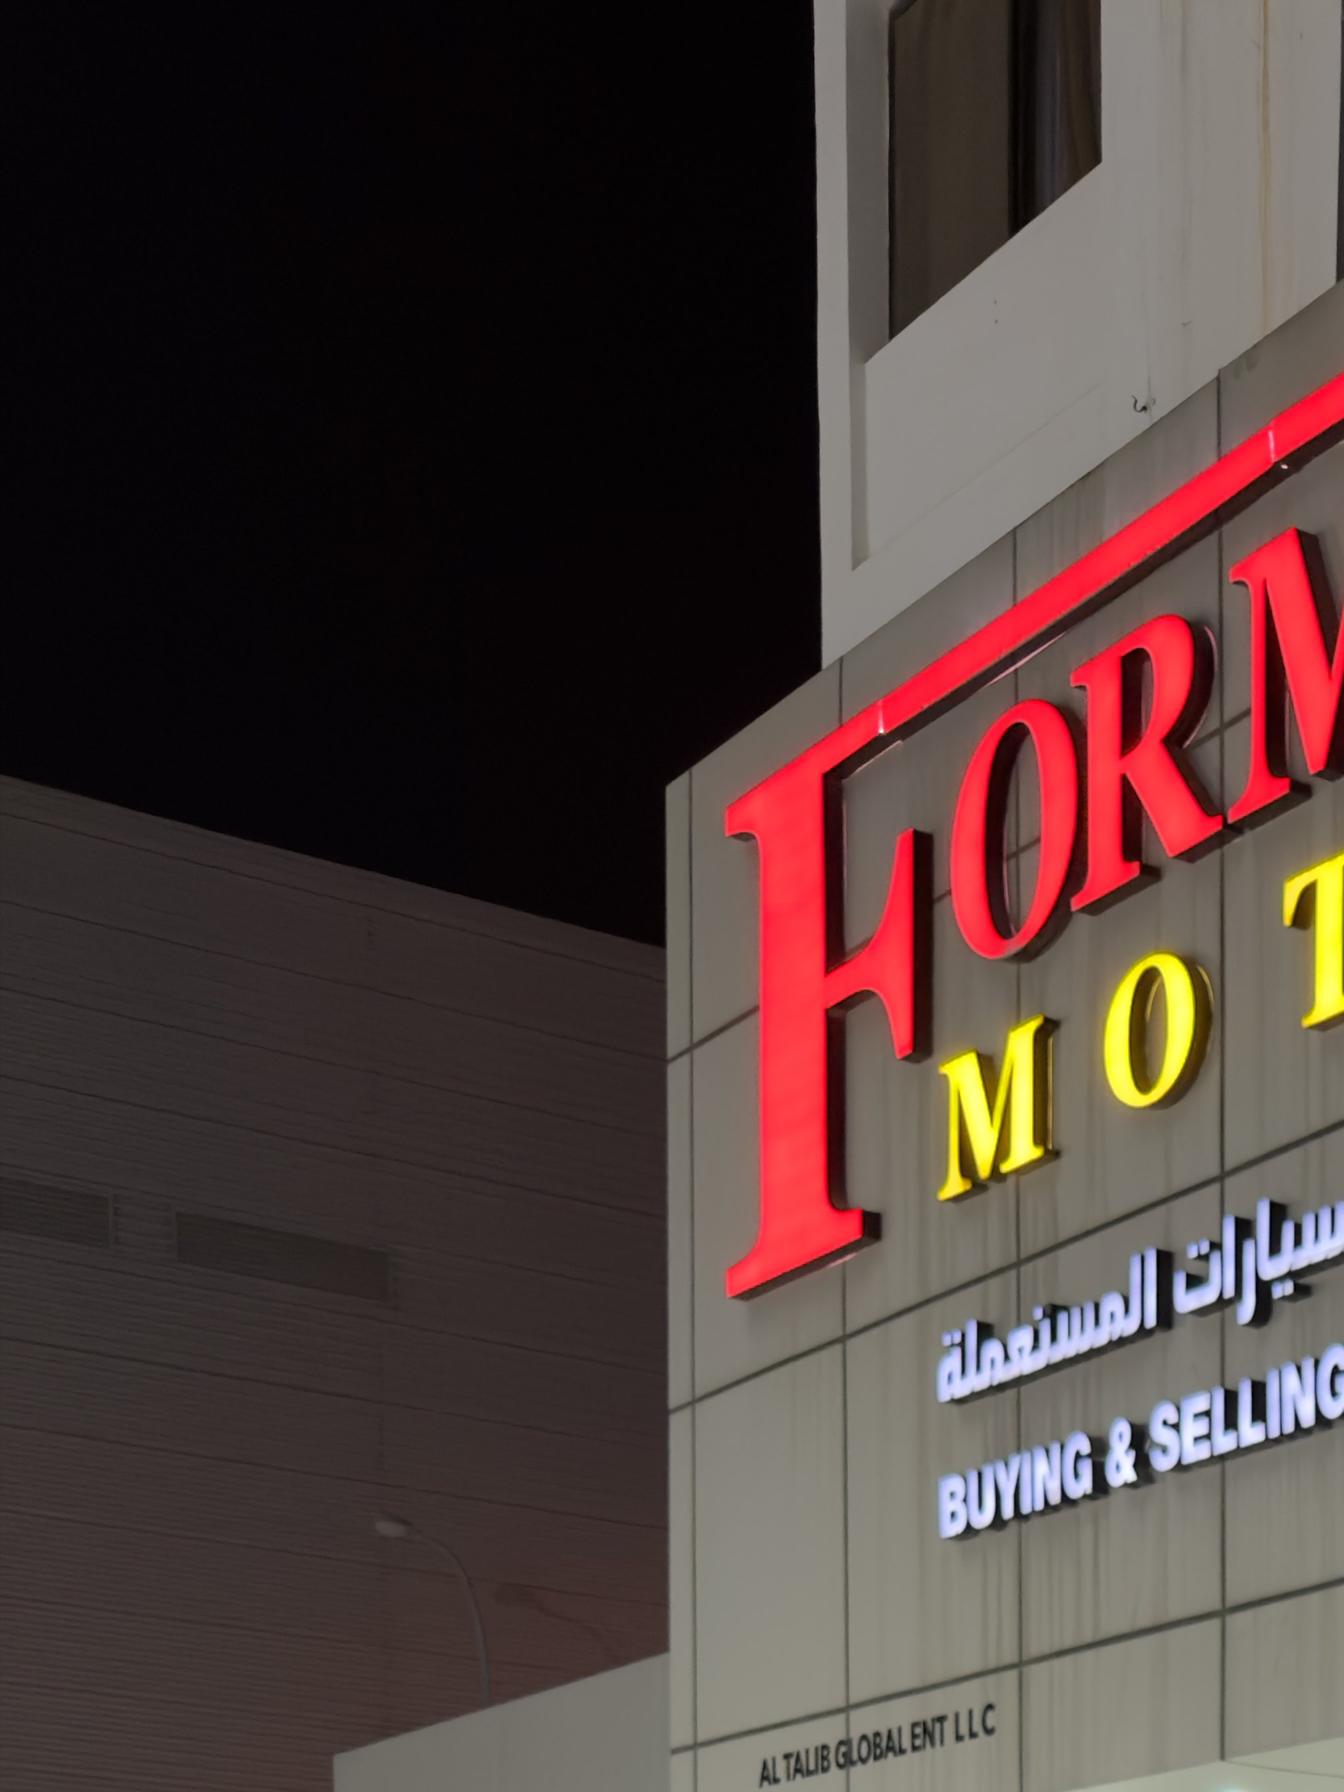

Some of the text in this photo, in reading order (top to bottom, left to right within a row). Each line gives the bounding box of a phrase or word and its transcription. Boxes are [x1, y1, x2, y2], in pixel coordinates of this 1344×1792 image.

[937, 1247, 1158, 1403] المستعملة
[937, 1430, 1093, 1539] BUYING
[1104, 1416, 1137, 1488] &
[758, 1757, 781, 1788] AL
[783, 1743, 832, 1782] TALIB
[835, 1724, 907, 1770] GLOBAL
[910, 1714, 948, 1753] ENT
